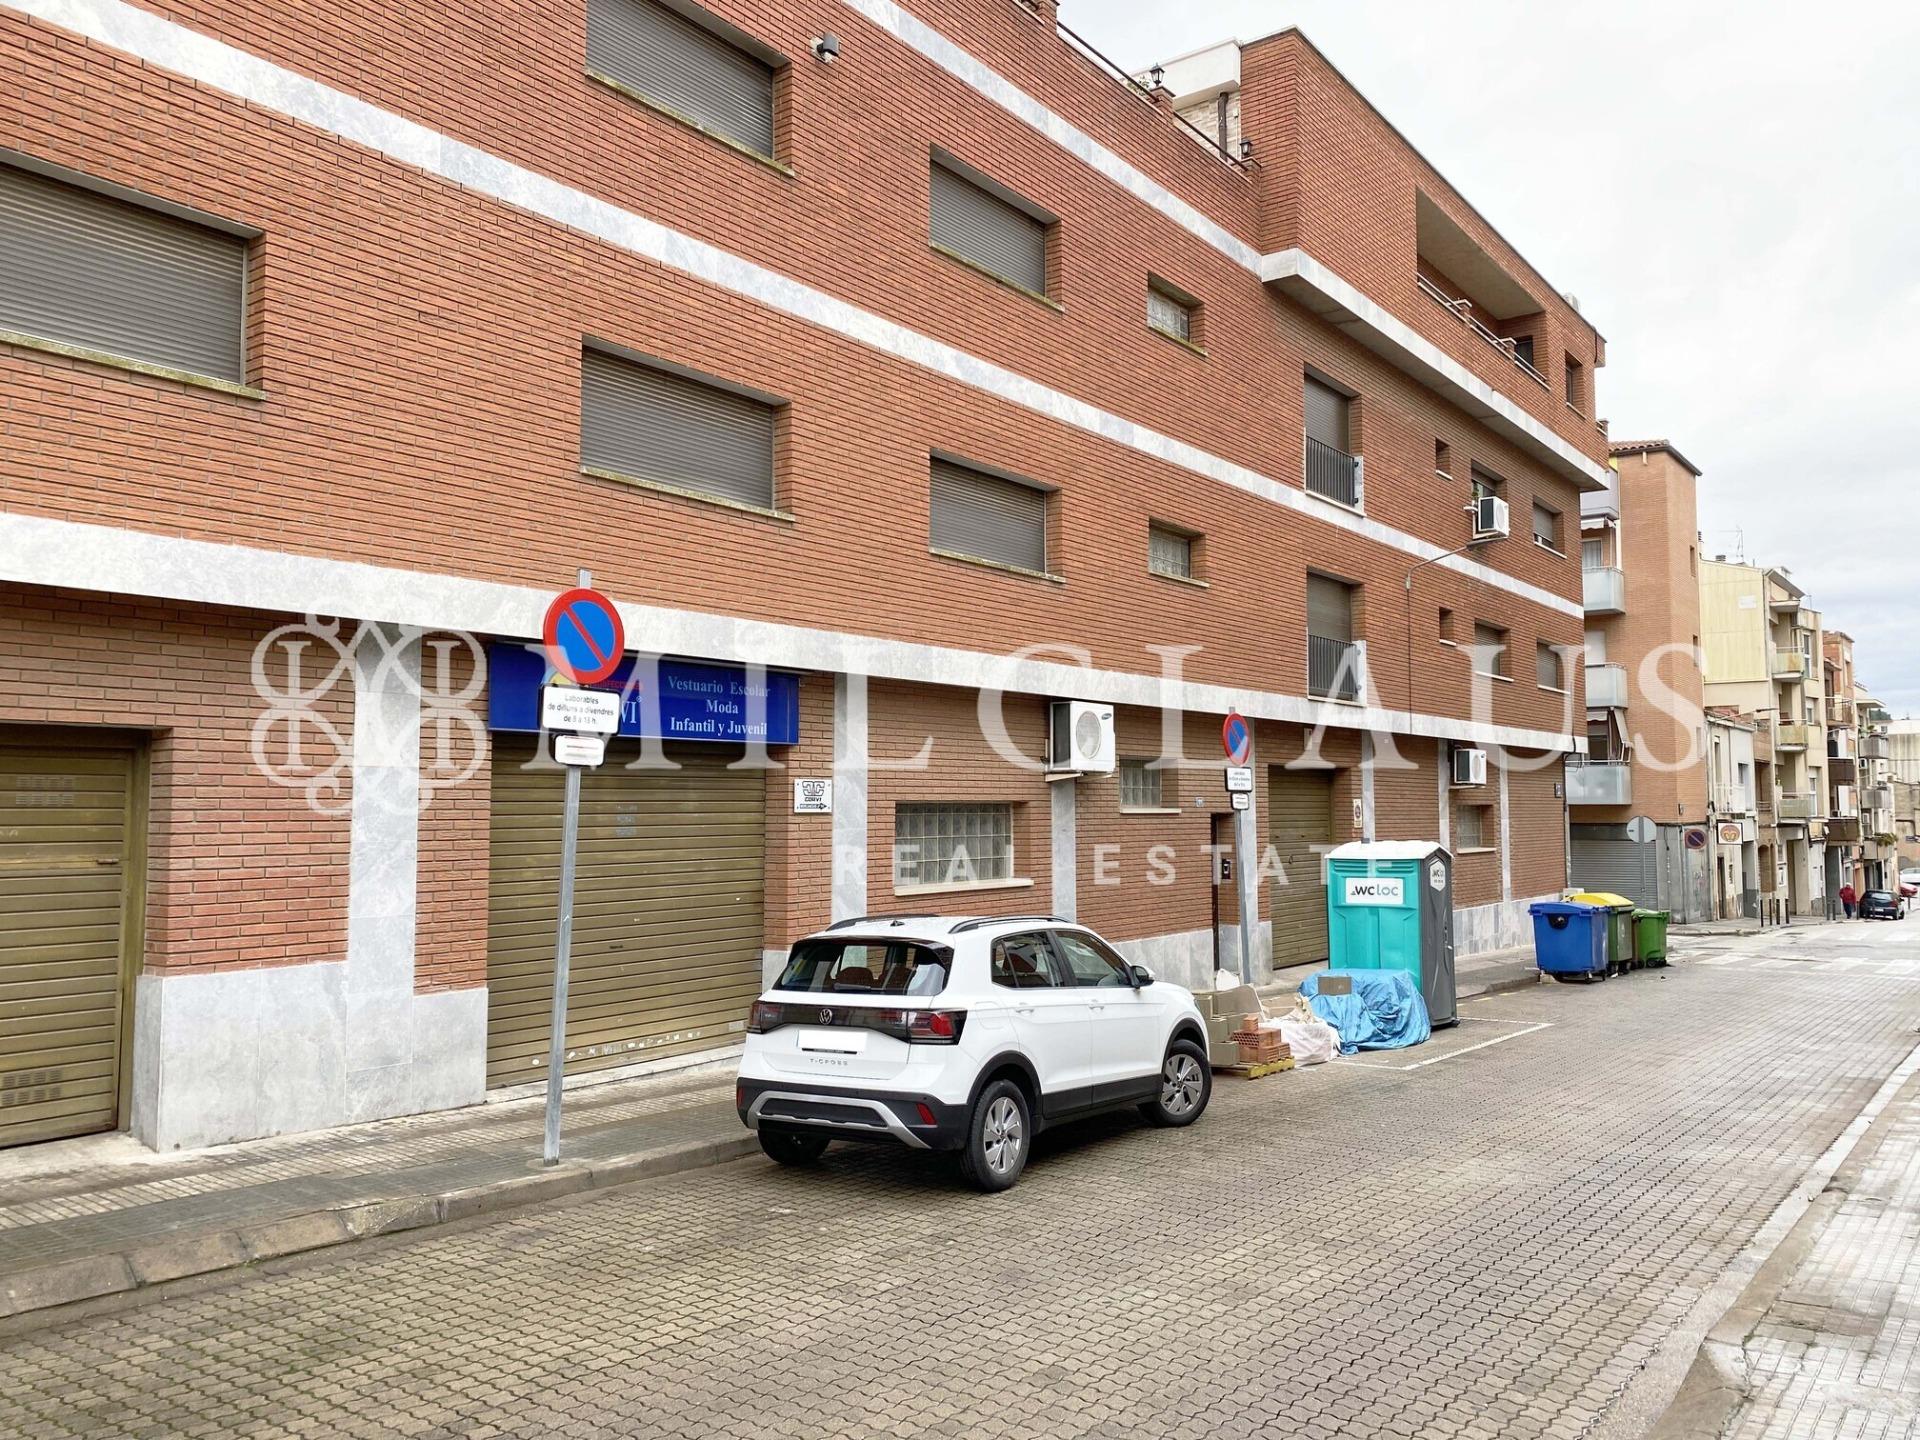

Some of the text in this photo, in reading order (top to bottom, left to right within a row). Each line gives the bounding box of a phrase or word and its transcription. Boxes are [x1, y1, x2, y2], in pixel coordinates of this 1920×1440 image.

[668, 675, 772, 698] Vestuario Escolar
[705, 699, 739, 715] Moda
[670, 716, 769, 737] Infantil y Juvenil
